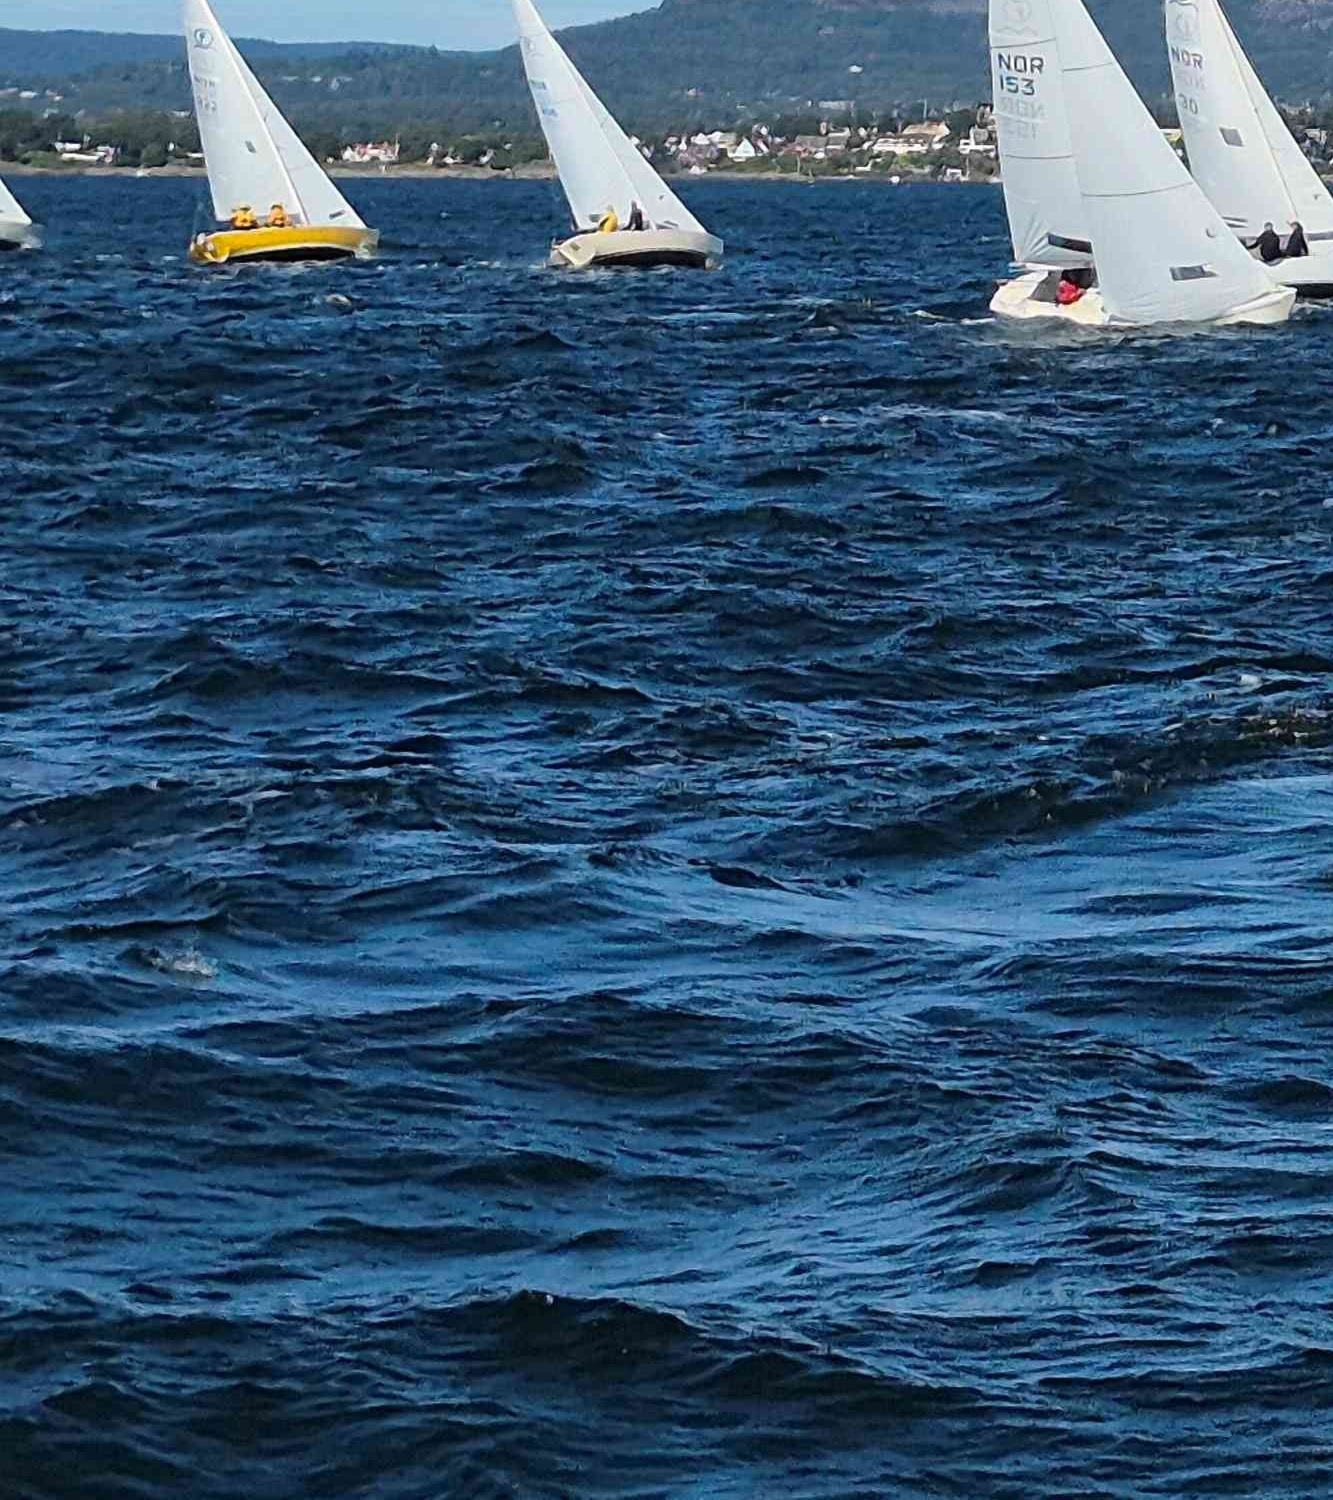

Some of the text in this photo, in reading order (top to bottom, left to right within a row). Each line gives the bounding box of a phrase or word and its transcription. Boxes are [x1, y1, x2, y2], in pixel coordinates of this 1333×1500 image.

[997, 53, 1045, 75] NOR
[1171, 46, 1204, 69] NOR
[999, 75, 1036, 96] 153
